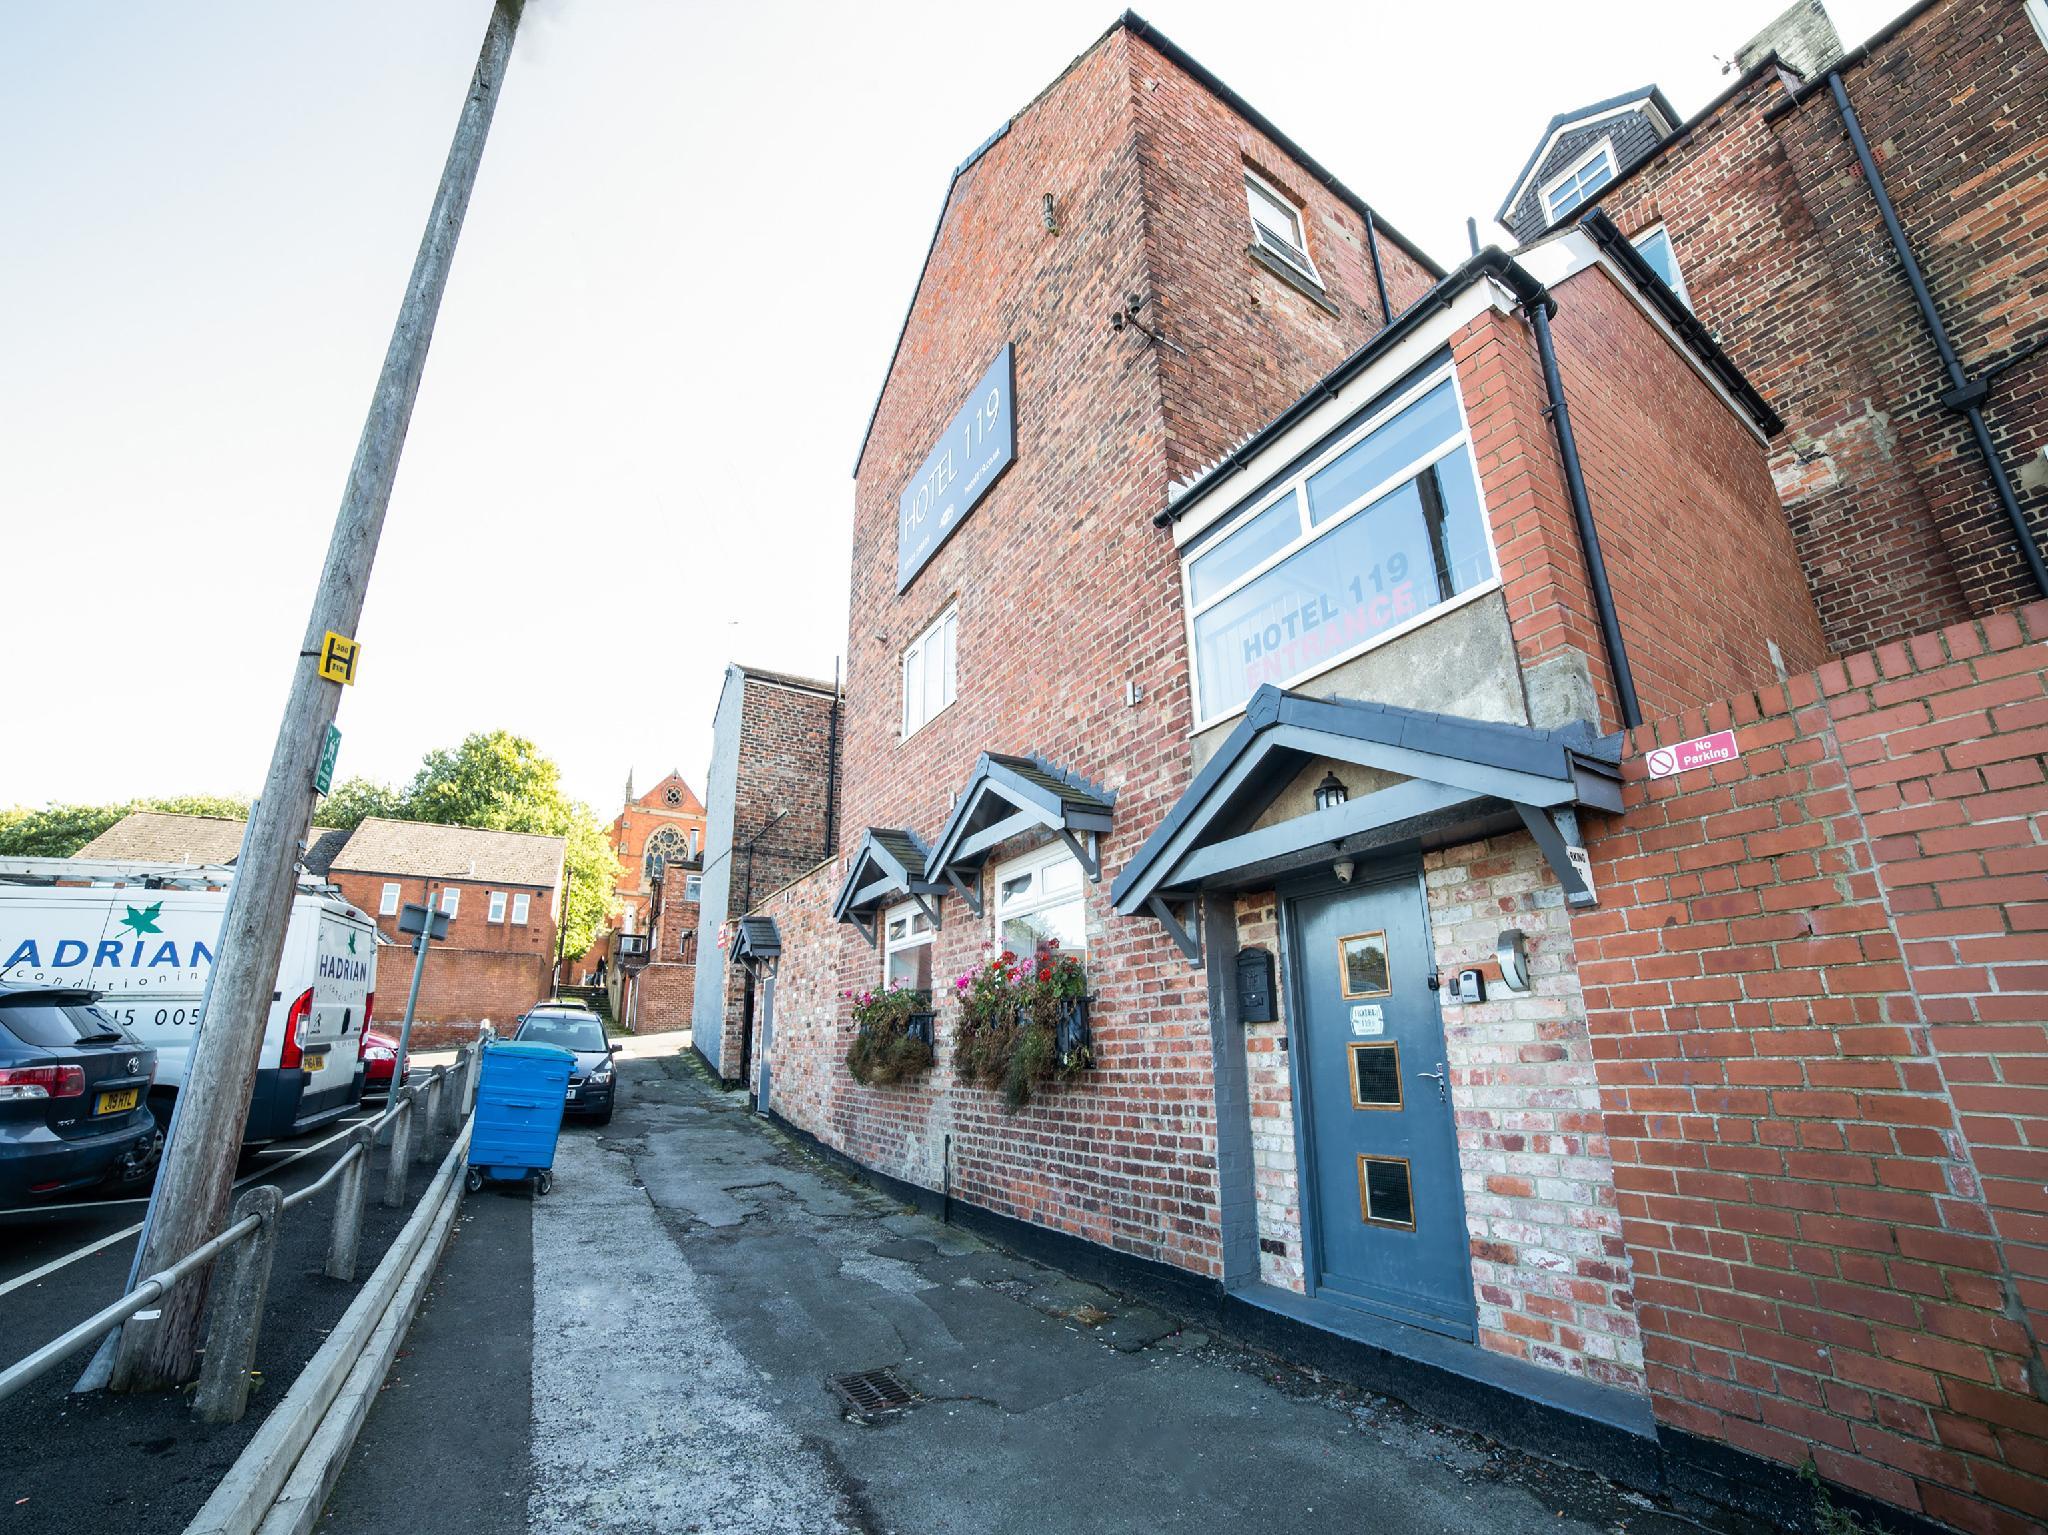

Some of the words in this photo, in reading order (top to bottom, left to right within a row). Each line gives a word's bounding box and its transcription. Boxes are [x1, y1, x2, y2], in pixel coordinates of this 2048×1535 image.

[904, 448, 958, 541] HOTEL
[964, 388, 1000, 459] 119
[1243, 593, 1339, 664] HOTEL
[1349, 552, 1409, 604] 119
[1246, 579, 1417, 690] ENTRANCE
[325, 637, 356, 680] H
[1683, 747, 1729, 766] Parking
[1694, 741, 1711, 752] No
[2, 939, 214, 968] ADRIAN
[319, 954, 367, 982] HADRIAN
[16, 969, 209, 991] conditionin
